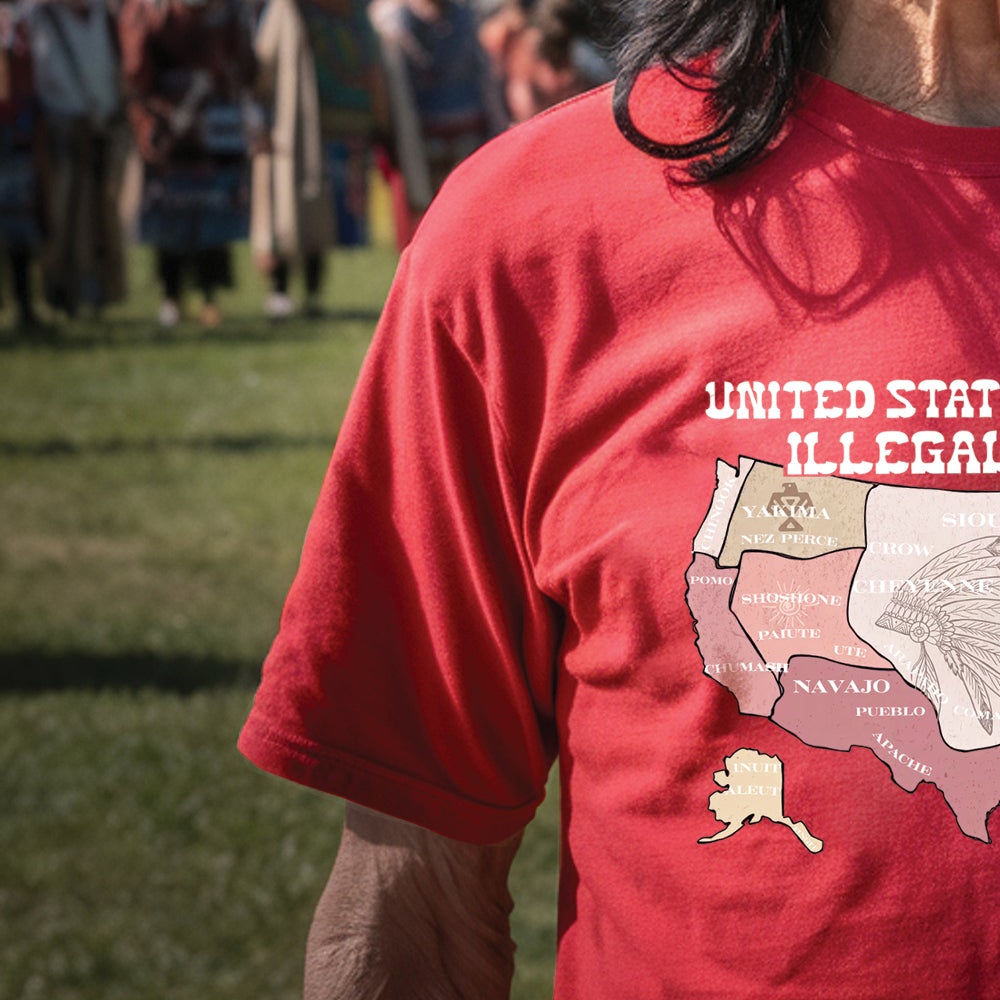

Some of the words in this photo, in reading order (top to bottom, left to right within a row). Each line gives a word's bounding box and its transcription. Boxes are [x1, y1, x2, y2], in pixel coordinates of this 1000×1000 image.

[705, 379, 875, 419] UNITED
[700, 477, 737, 551] CHINOOK
[741, 505, 831, 520] YAKIMA
[741, 534, 775, 545] NEZ
[781, 533, 838, 547] PERCE
[868, 541, 935, 557] CROW
[690, 576, 733, 586] POMO
[851, 579, 994, 594] CHEYENNE
[741, 593, 842, 606] SHOSHONE
[758, 628, 821, 641] PAIUTE
[833, 645, 867, 658] UTE
[704, 662, 789, 674] CHUMASH
[793, 679, 891, 694] NAVAJO
[855, 706, 926, 717] PUEBLO
[872, 732, 933, 776] APACHE
[733, 762, 779, 773] INUIT
[725, 785, 779, 796] ALEUT
